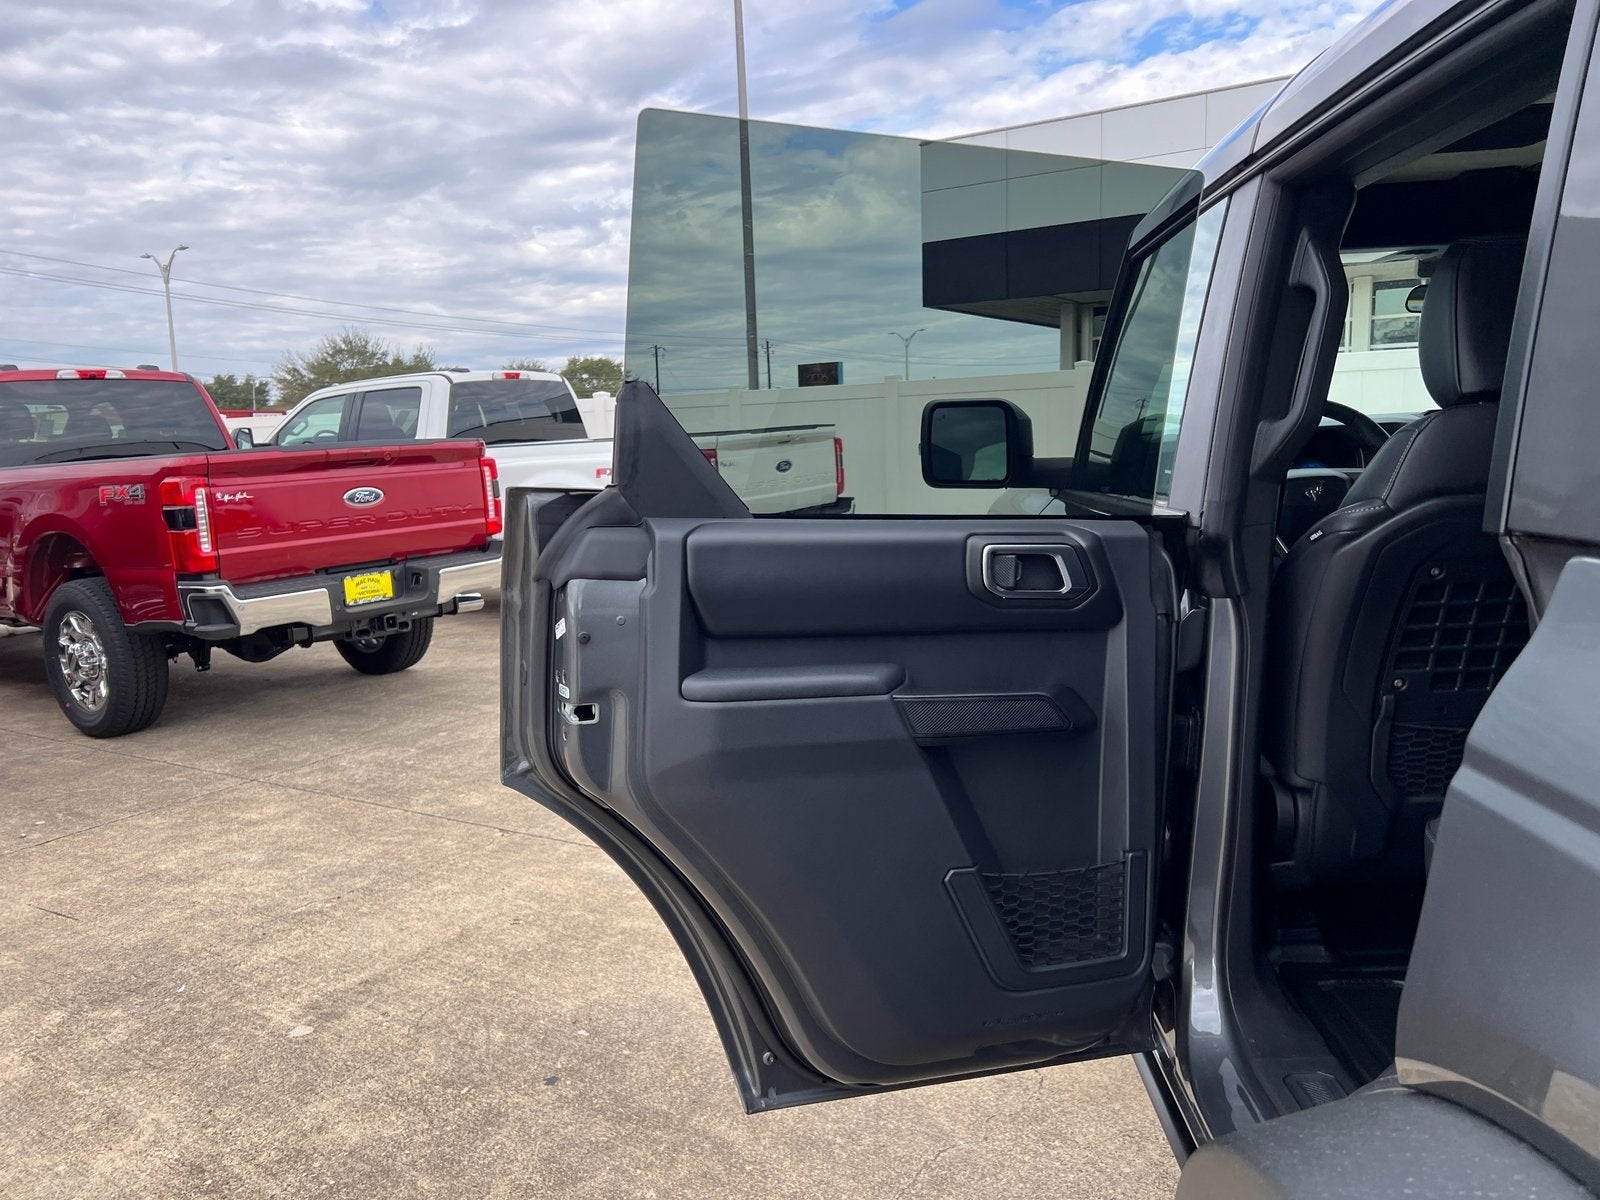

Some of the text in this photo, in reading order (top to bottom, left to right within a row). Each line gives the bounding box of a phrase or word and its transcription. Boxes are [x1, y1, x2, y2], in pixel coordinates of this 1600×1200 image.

[99, 484, 145, 505] FX4
[236, 504, 473, 539] SUPER DUTY
